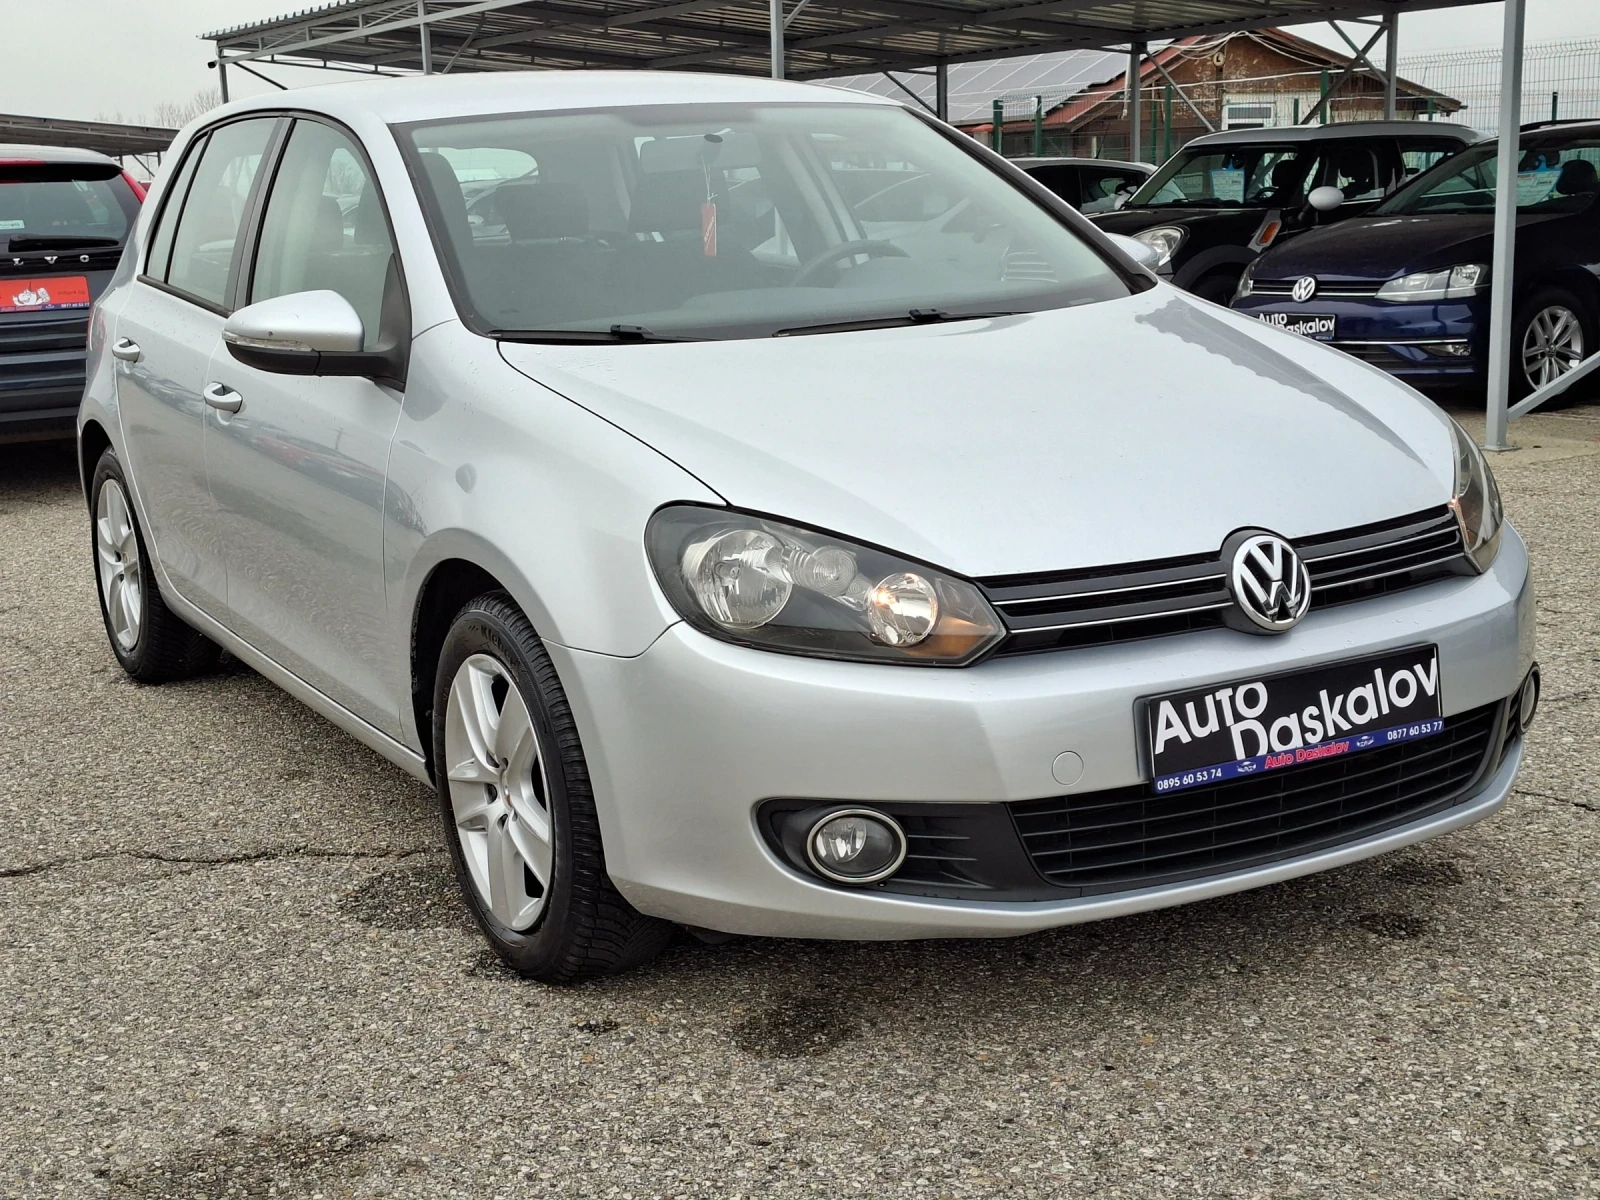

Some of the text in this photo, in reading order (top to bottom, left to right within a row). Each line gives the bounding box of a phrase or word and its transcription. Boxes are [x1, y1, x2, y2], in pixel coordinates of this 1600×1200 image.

[1230, 657, 1440, 761] Daskalov
[1387, 720, 1443, 741] 0877 60 53 77
[1265, 741, 1350, 770] Auto Daskalov
[1157, 767, 1222, 791] 0895 60 53 74
